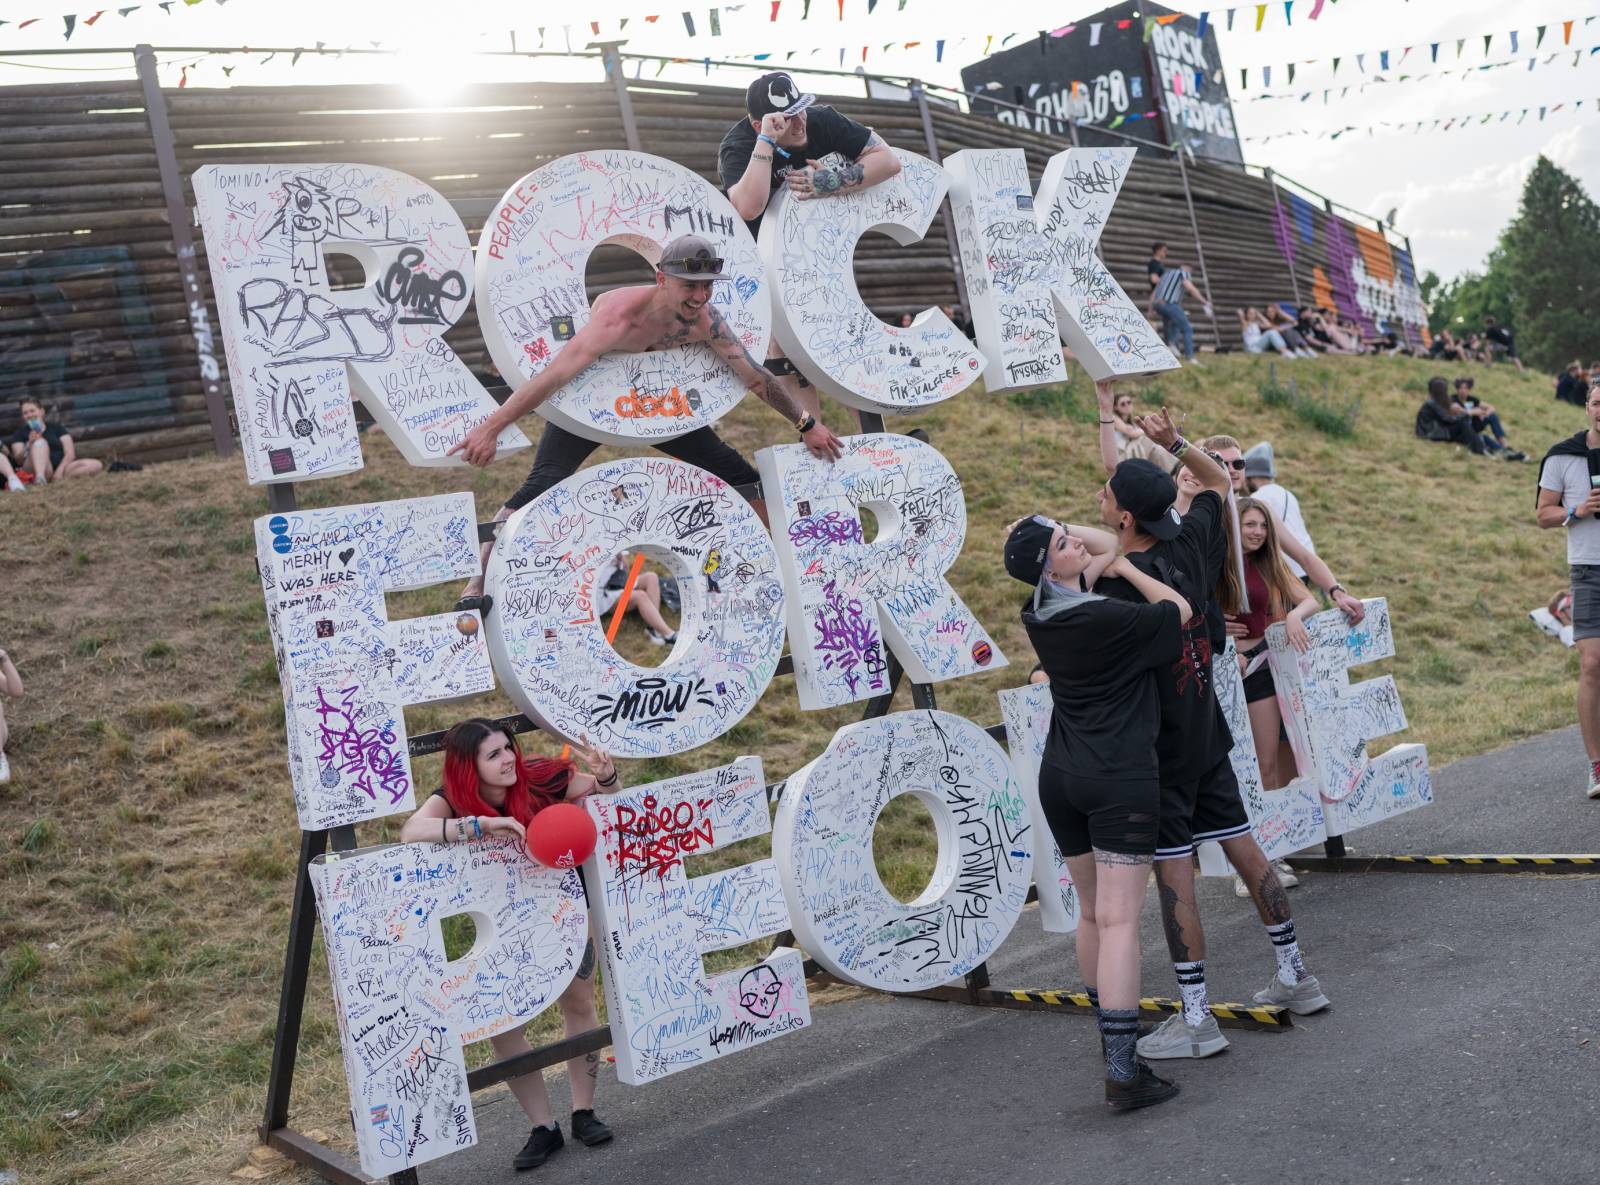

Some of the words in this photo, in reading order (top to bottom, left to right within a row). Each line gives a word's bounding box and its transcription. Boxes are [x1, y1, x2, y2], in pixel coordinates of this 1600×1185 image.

[1152, 22, 1209, 71] ROCK
[1164, 90, 1236, 140] PEOPLE
[488, 187, 534, 260] PEOPLE
[190, 145, 1182, 485] ROCK
[378, 364, 431, 397] VOJTA
[408, 378, 468, 407] MARIAN
[283, 550, 332, 573] MERHY
[506, 556, 528, 572] TOO
[281, 577, 314, 602] WAS
[320, 570, 357, 585] HERE
[253, 428, 1010, 831] FOR
[610, 680, 693, 724] MIOW
[308, 595, 1437, 1180] PEOLE
